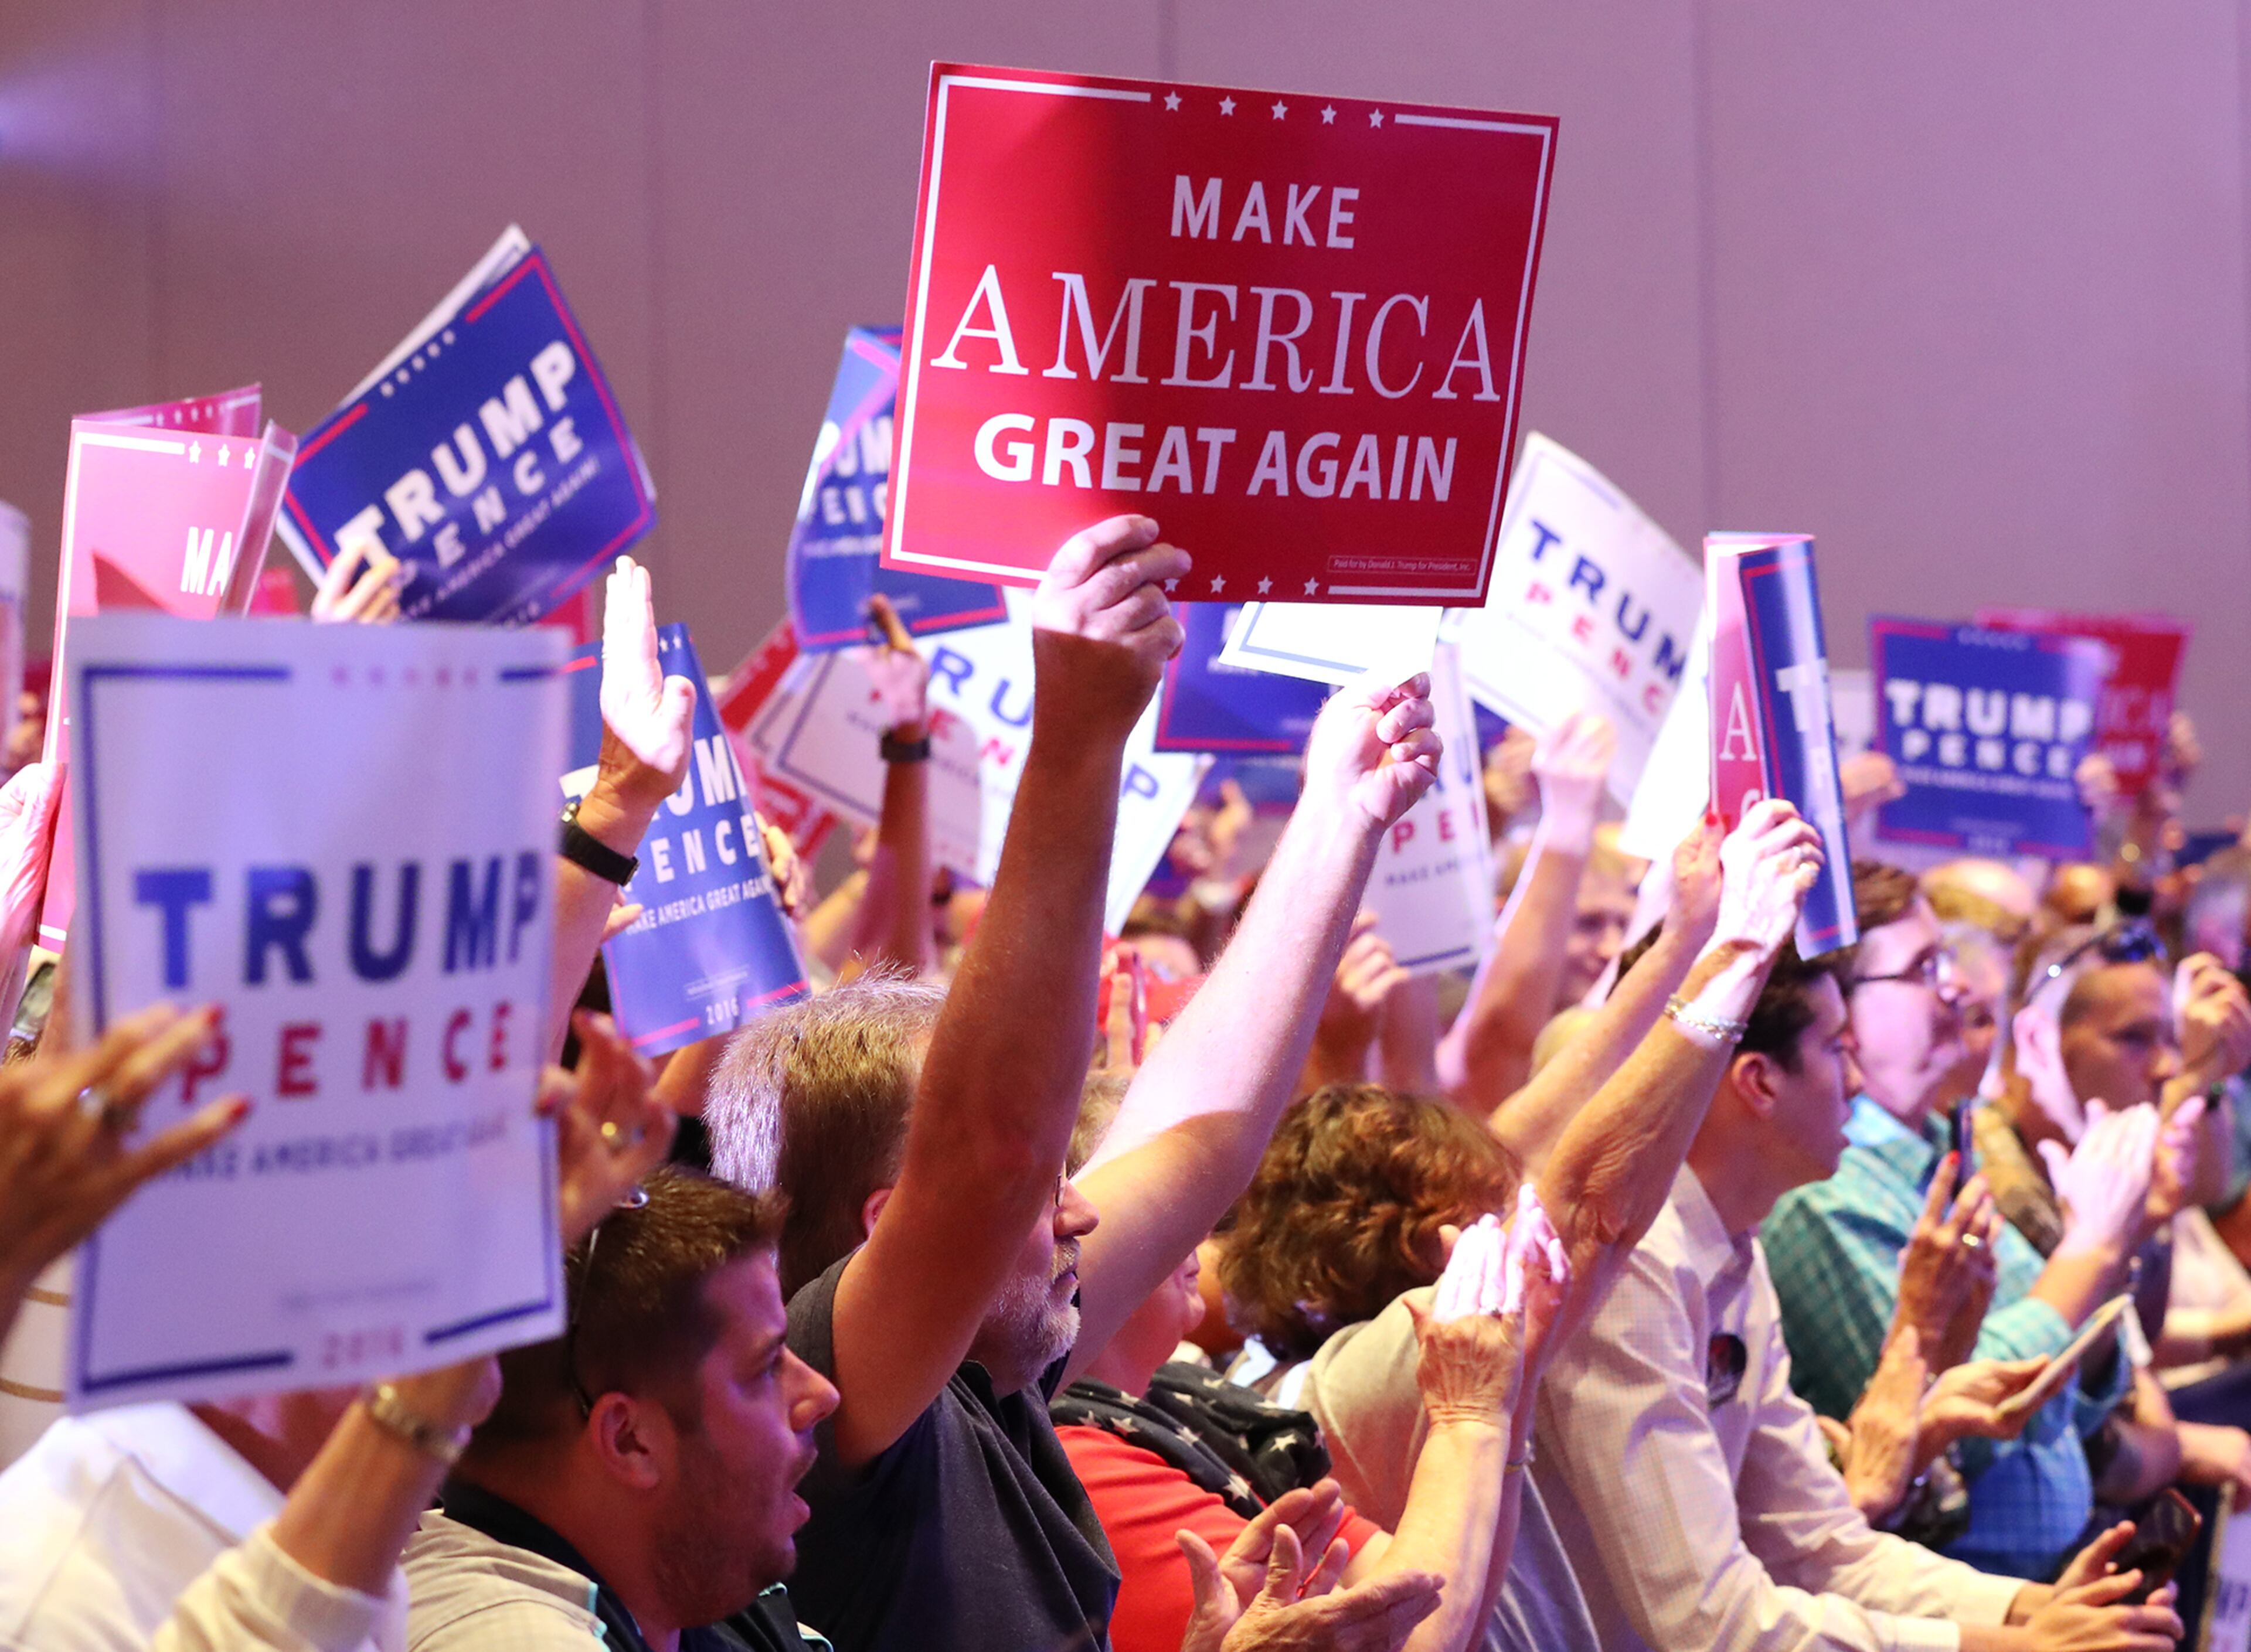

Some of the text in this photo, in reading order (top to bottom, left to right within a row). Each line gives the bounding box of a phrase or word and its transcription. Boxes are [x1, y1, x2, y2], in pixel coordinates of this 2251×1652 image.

[1170, 174, 1361, 250] MAKE
[930, 264, 1501, 403] AMERICA
[333, 339, 576, 560] TRUMP
[973, 413, 1237, 495] GREAT
[1246, 430, 1458, 502] AGAIN
[1884, 677, 2092, 743] TRUMP
[625, 813, 762, 892] ENCE
[134, 849, 542, 990] TRUMP
[657, 894, 706, 925] AMERICA
[705, 883, 741, 911] GREAT
[705, 996, 739, 1025] 2016
